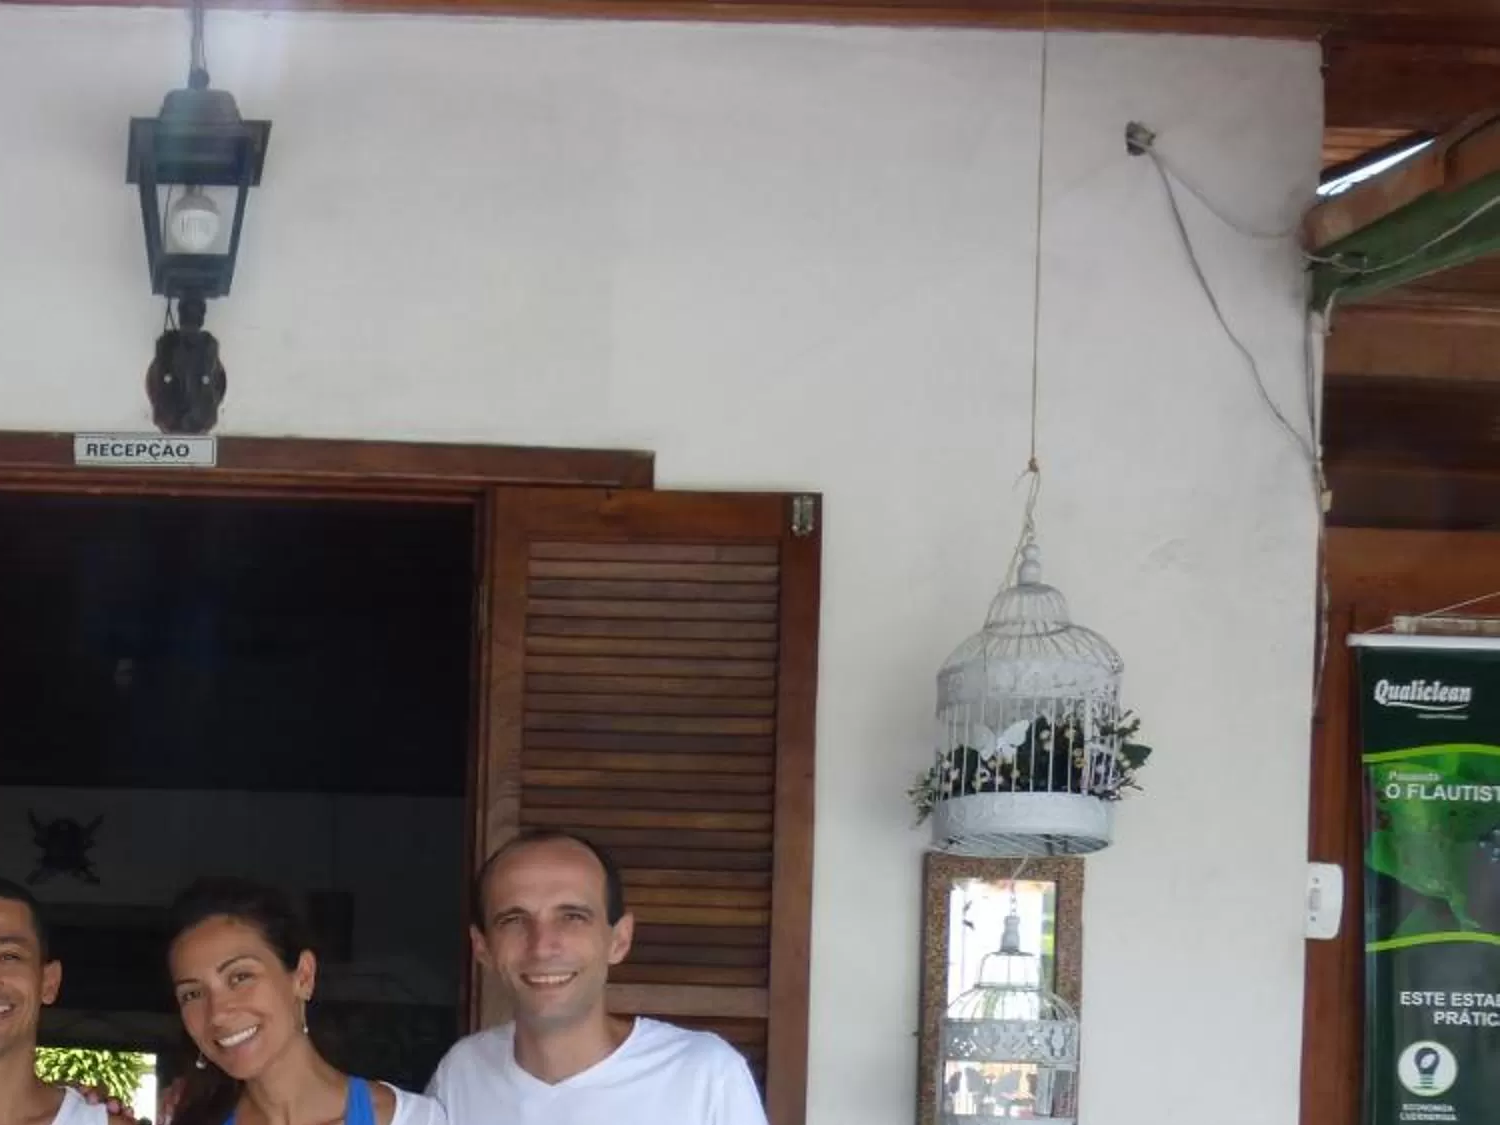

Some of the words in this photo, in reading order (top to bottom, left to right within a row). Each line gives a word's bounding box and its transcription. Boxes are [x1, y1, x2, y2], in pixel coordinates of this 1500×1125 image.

[1373, 679, 1472, 705] Qualiclean
[1385, 783, 1400, 800] O
[1400, 991, 1445, 1007] ESTE
